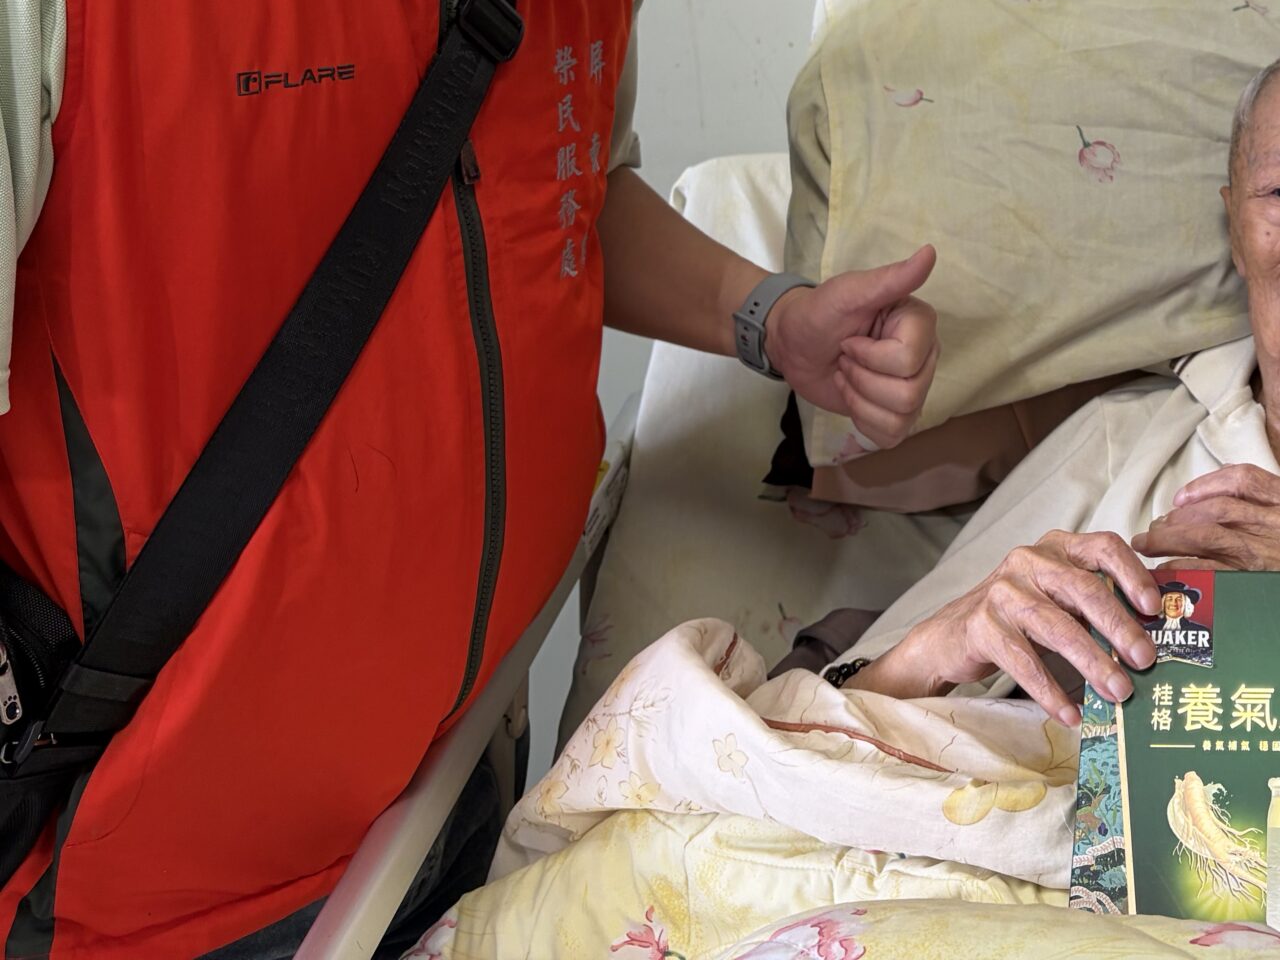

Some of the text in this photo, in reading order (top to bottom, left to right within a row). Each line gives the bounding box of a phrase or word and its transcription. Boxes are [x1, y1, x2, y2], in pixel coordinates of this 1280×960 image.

[264, 64, 355, 90] FLARE
[1147, 629, 1210, 648] UAKER
[1151, 683, 1174, 732] 桂格
